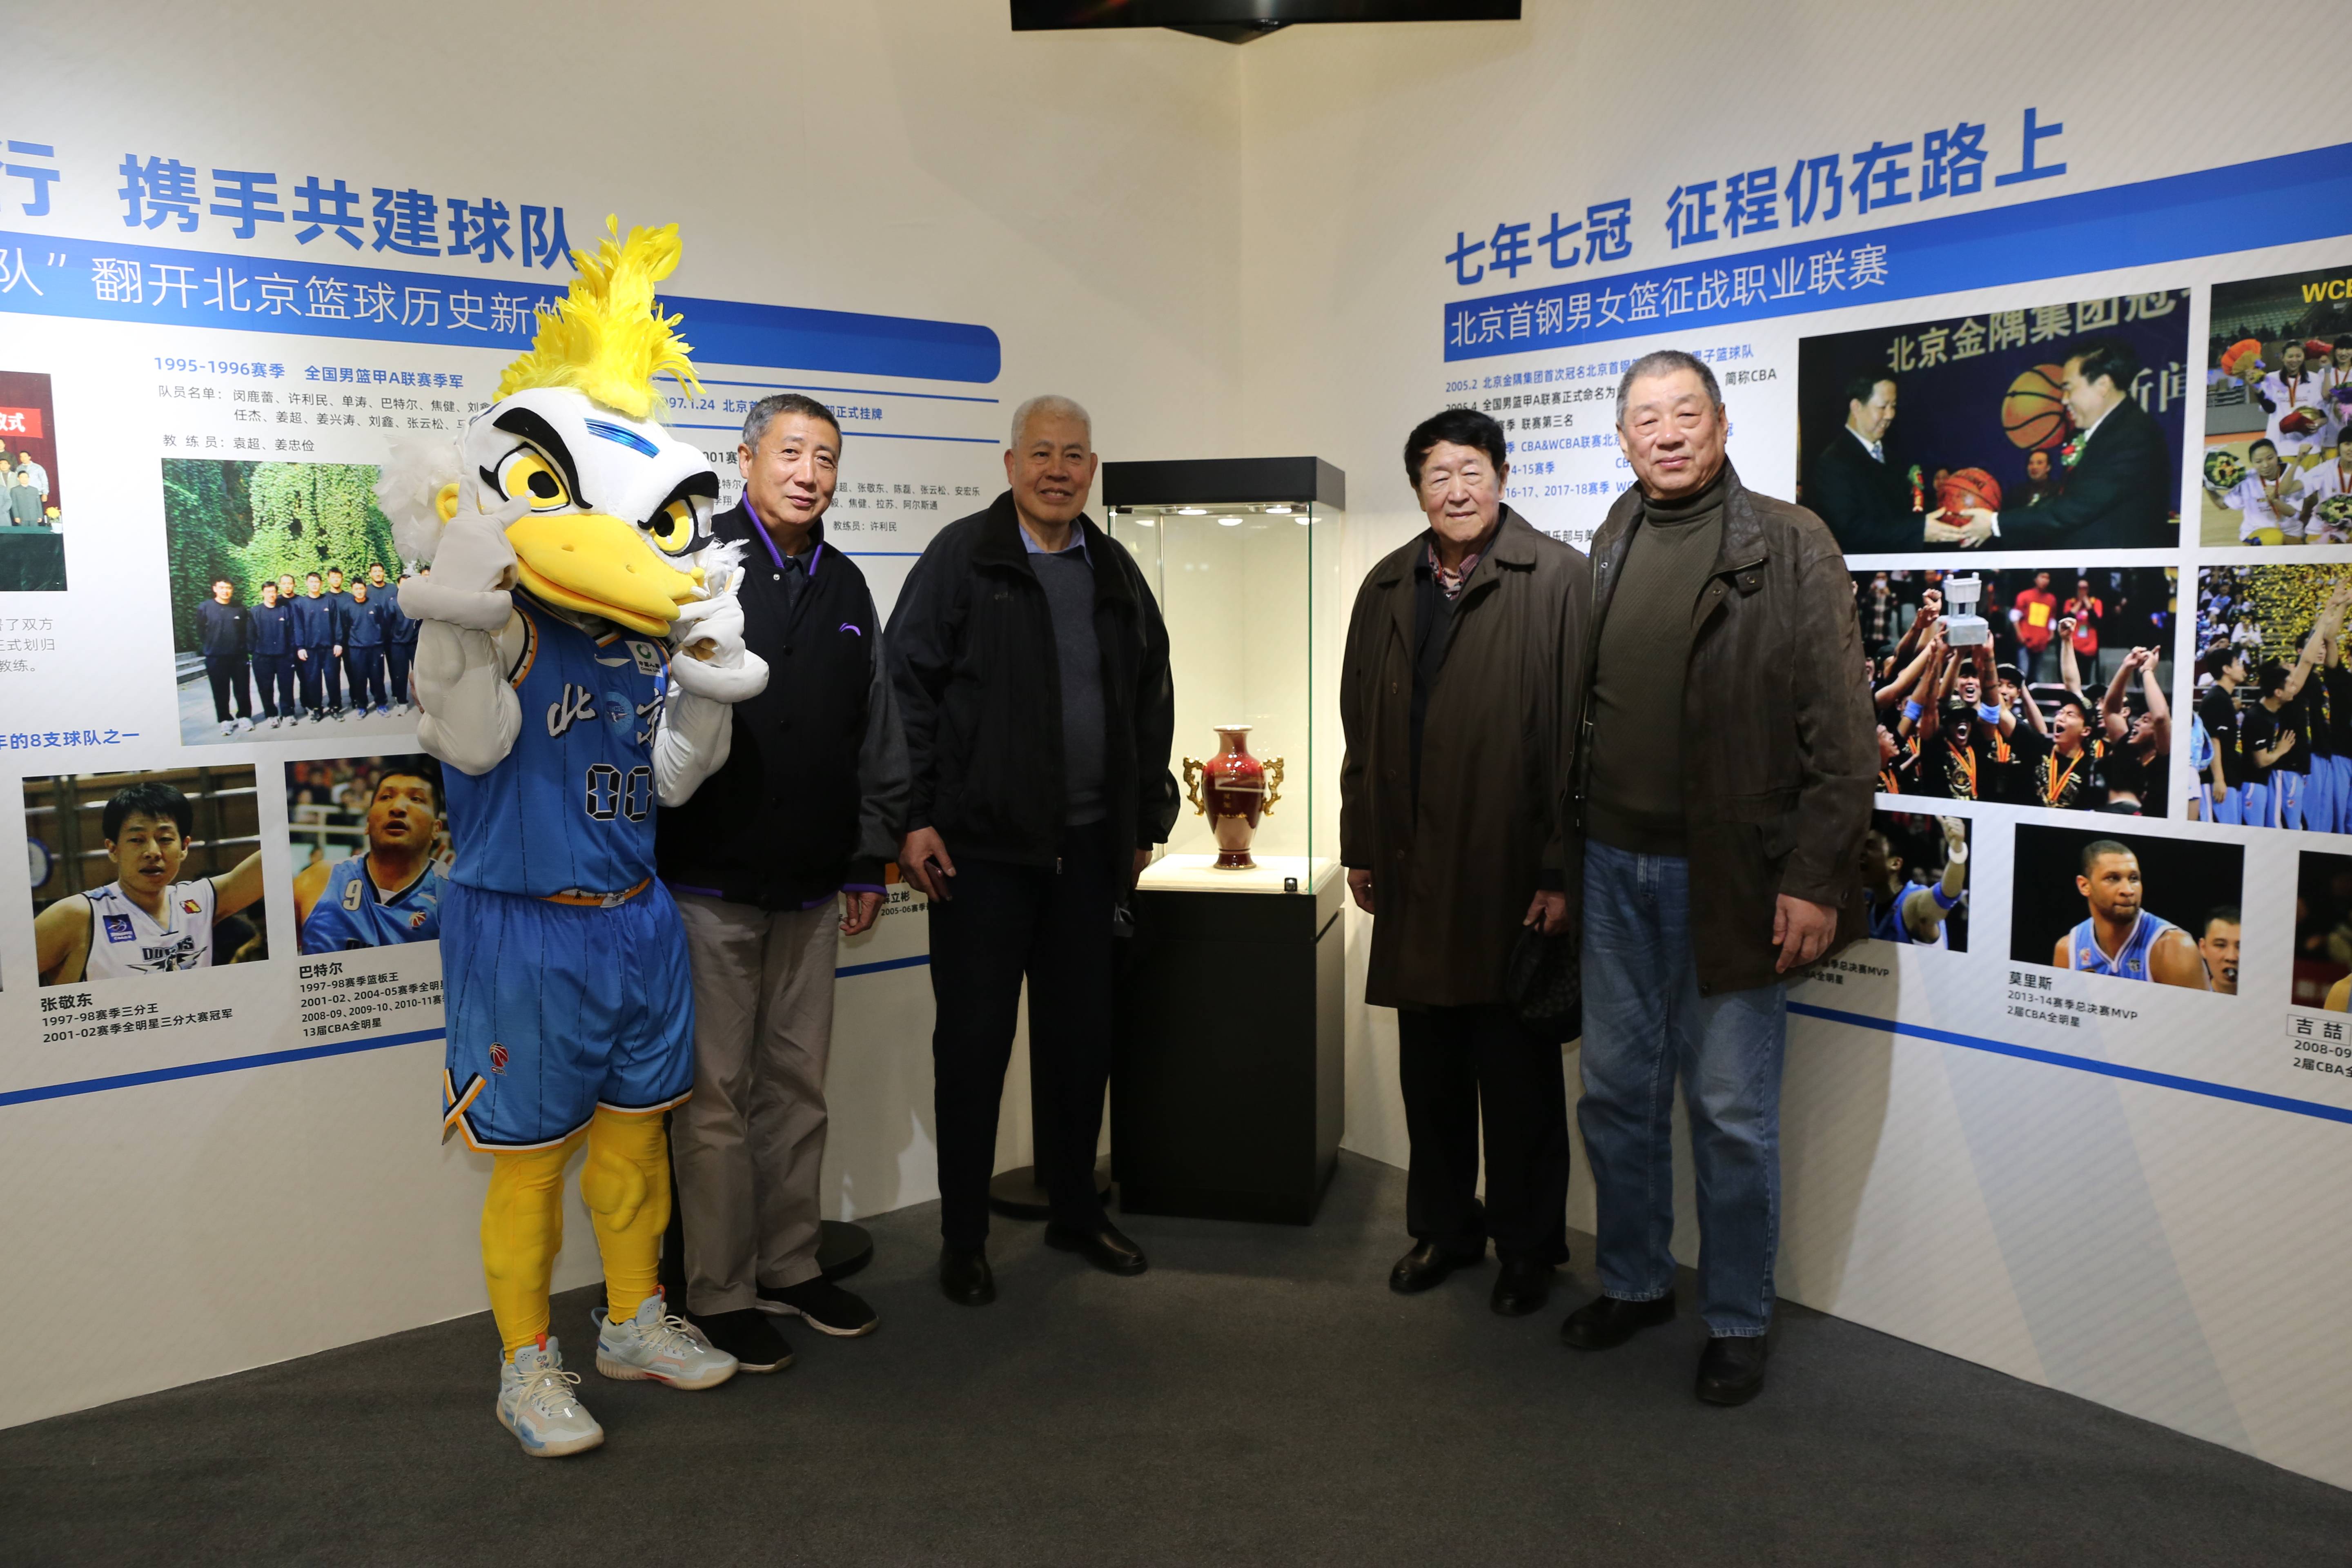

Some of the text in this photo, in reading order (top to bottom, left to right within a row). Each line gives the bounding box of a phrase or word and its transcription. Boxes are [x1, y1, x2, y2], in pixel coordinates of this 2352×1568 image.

[1445, 107, 2067, 285] 七年七冠 征程仍在路上
[118, 153, 578, 272] 携手共建球队
[1450, 243, 1889, 347] 北京首钢男女篮征战职业联赛
[1887, 288, 2190, 373] 北京金隅集团冠
[155, 357, 464, 389] 1995-1996赛季 全国男篮甲A联赛季军
[1446, 379, 1477, 392] 2005.2
[1483, 386, 1619, 412] 全国男篮甲A联赛正式命名为
[1725, 368, 1777, 385] 简称CBA
[666, 397, 715, 410] 97.1.24
[1522, 414, 1573, 430] 联赛第三名
[0, 618, 53, 632] 了双方
[586, 763, 654, 822] 00
[343, 879, 363, 911] 9
[881, 902, 929, 916] 2005-06赛季
[299, 962, 343, 979] 巴特尔
[2009, 971, 2052, 991] 莫里斯
[300, 971, 399, 993] 1997-98赛季篮板王
[41, 993, 93, 1012] 张敬东
[2008, 990, 2138, 1020] 2013-14赛季总决赛MVP
[42, 1003, 158, 1027] 1997-98赛季三分王
[43, 1008, 233, 1043] 2001-02赛季全明星三分大赛冠军
[2007, 1005, 2081, 1027] 2届CBA全明星
[303, 1017, 382, 1037] 13届CBA全明星
[2294, 1040, 2351, 1058] 2008-09
